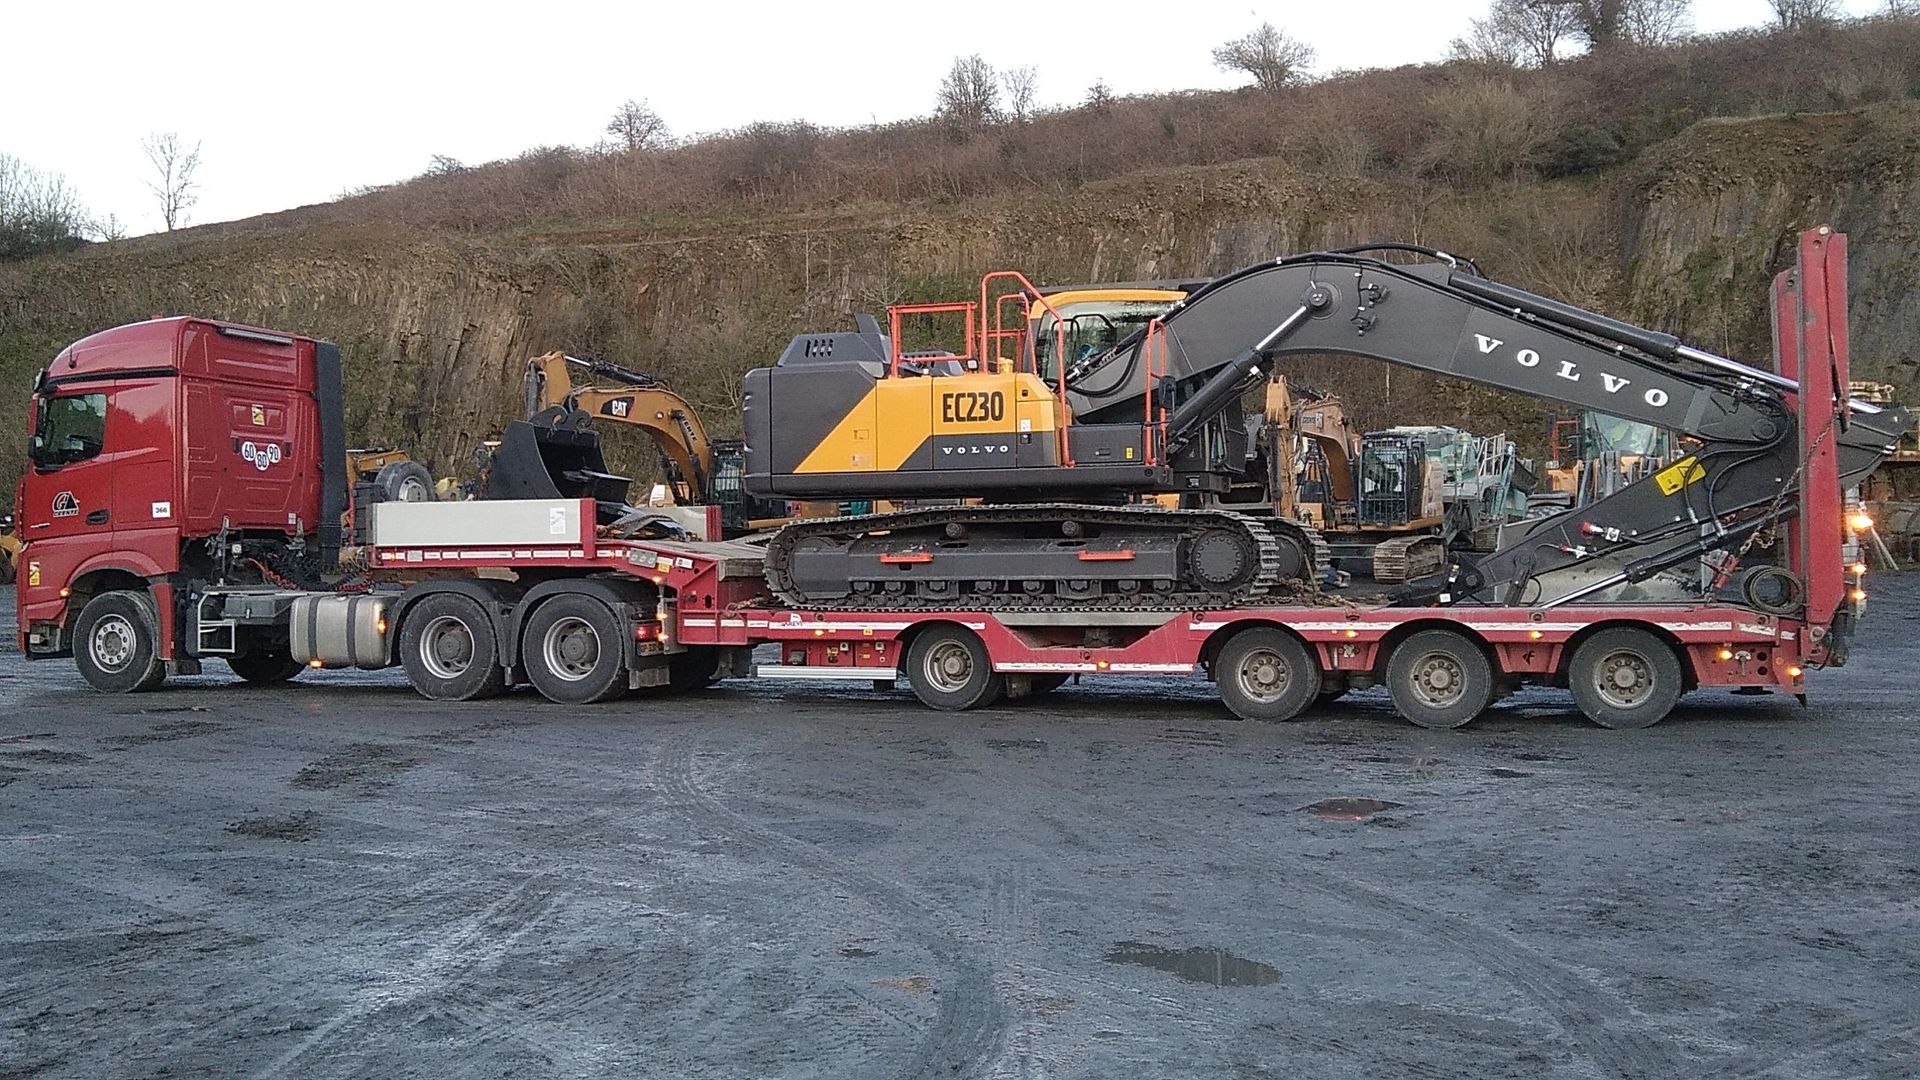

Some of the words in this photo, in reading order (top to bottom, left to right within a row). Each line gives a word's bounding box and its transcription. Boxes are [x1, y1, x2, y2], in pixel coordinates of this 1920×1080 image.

[1474, 333, 1669, 407] VOLVO
[612, 400, 628, 416] CAT
[943, 391, 1004, 422] EC230
[244, 444, 255, 459] 60
[269, 446, 279, 461] 90
[943, 445, 1008, 454] VOLVO
[257, 454, 267, 468] 80
